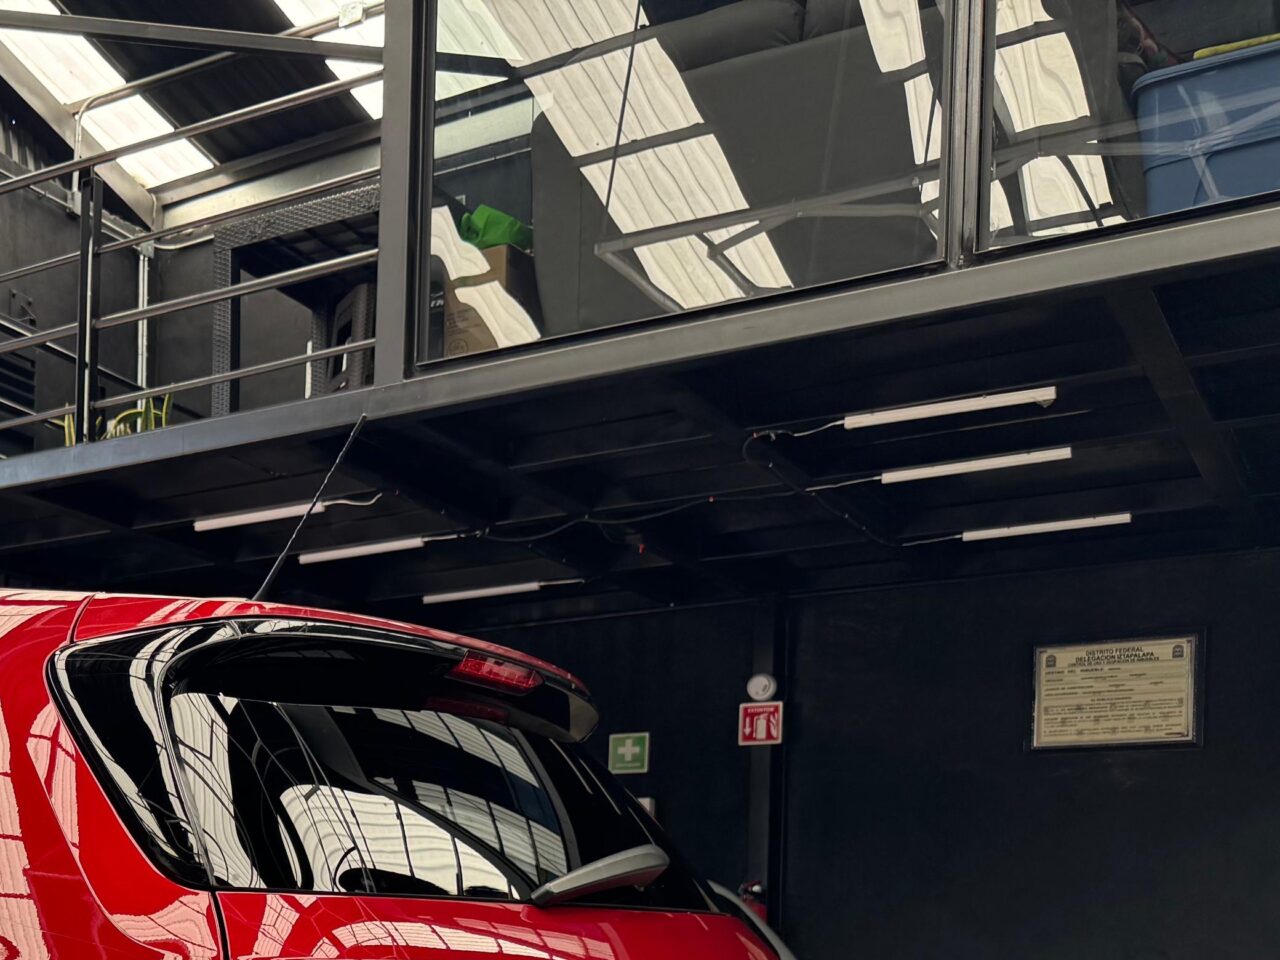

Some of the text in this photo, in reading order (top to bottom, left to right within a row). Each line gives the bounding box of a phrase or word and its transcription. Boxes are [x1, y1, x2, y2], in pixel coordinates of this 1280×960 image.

[1085, 646, 1143, 656] DISTRITO FEDERAL
[1117, 651, 1155, 660] IZTAPALAPA
